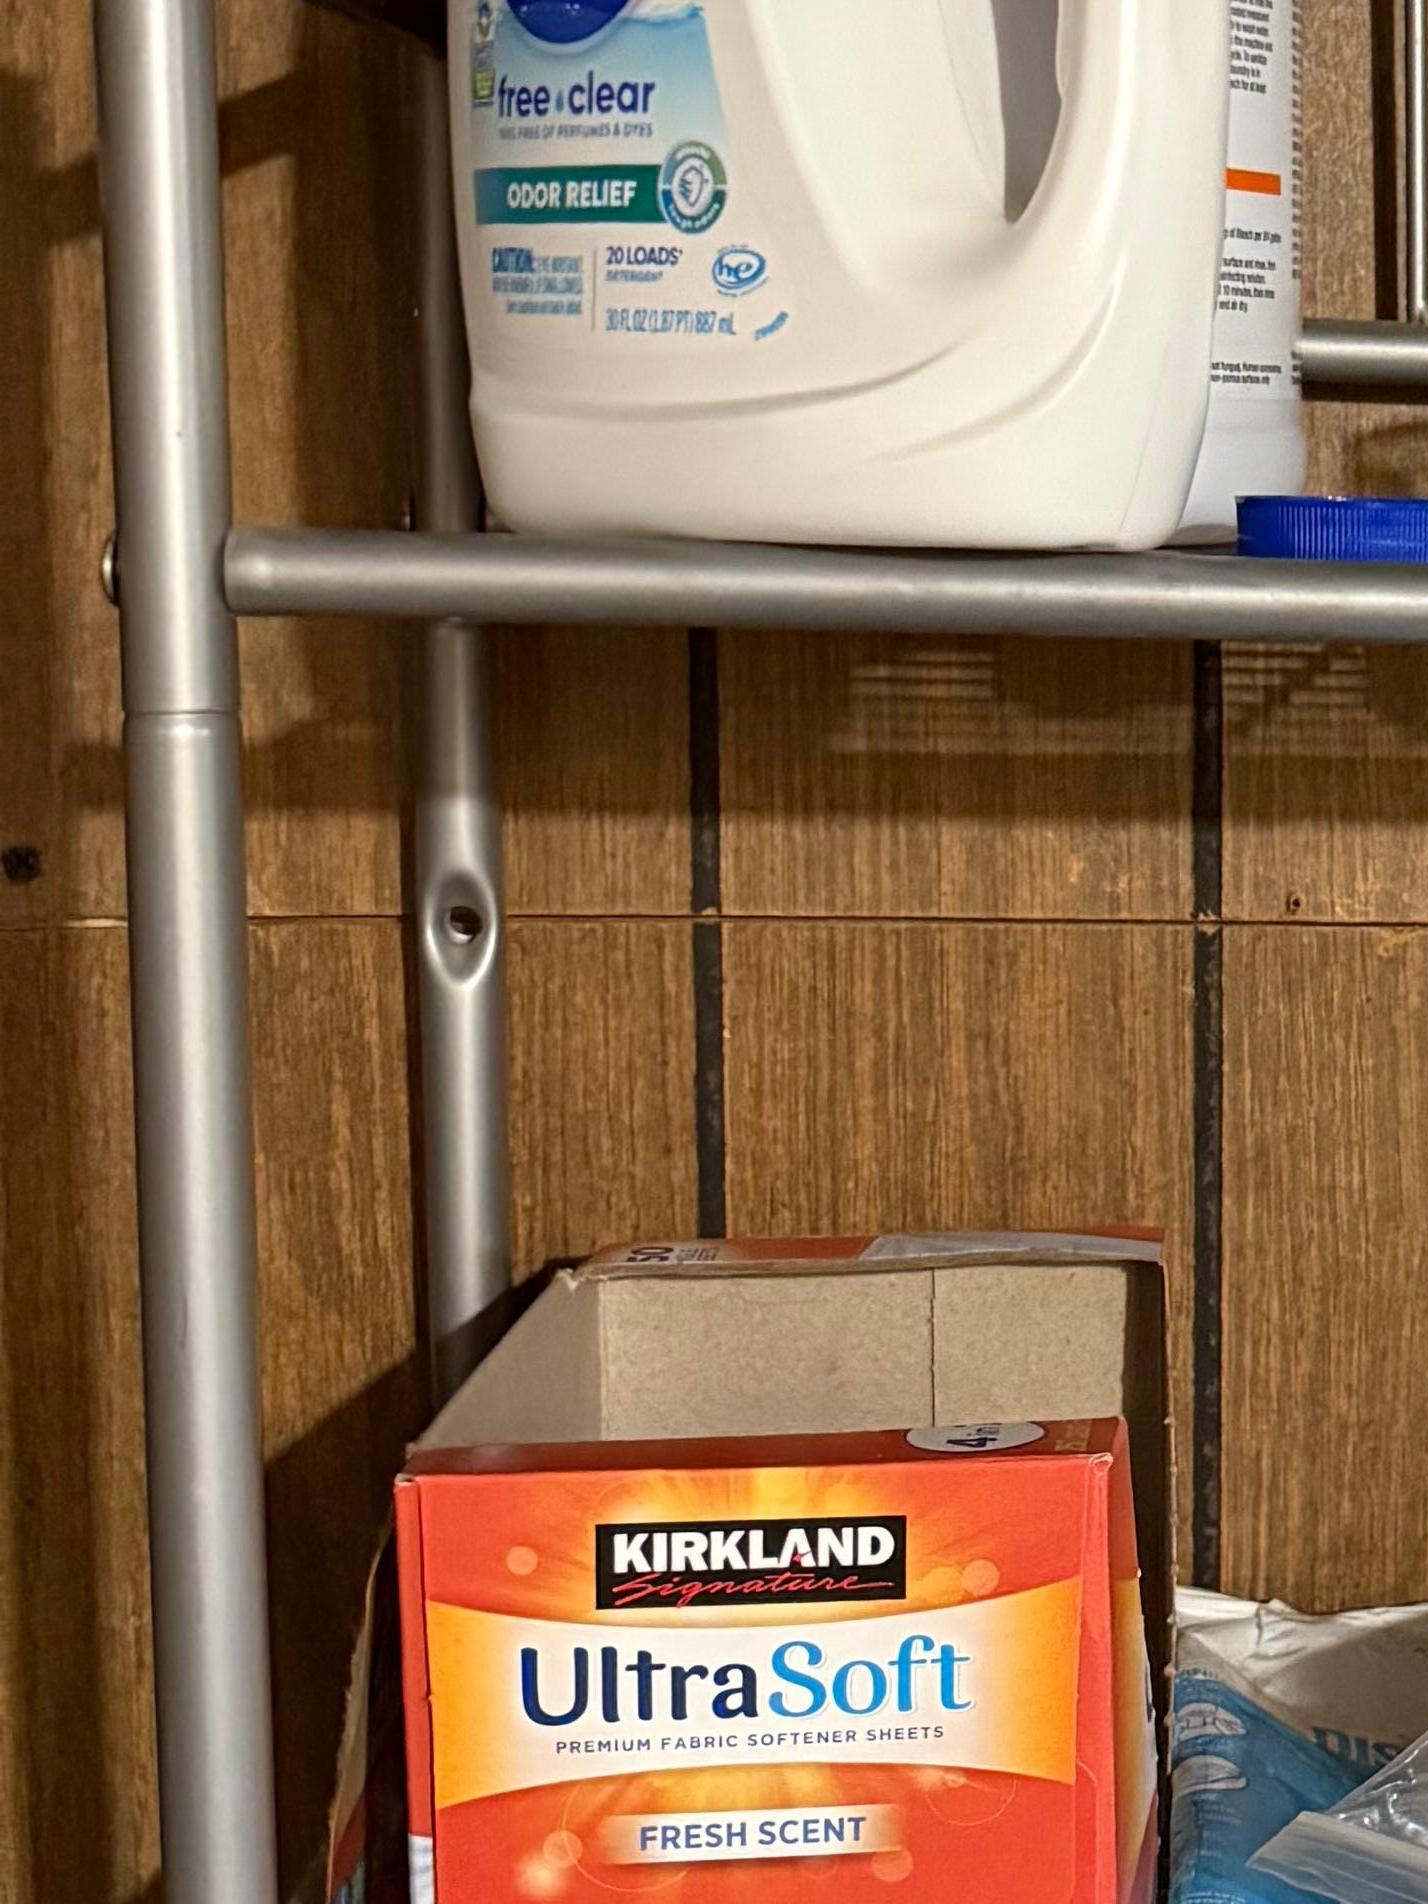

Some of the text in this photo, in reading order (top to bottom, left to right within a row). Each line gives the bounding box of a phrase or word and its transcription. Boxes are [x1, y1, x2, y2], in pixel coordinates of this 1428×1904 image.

[499, 75, 550, 117] free
[569, 70, 655, 114] clear
[557, 122, 611, 138] PERFUMES
[624, 122, 653, 137] DYES
[507, 180, 637, 209] ODOR RELIEF
[606, 247, 625, 266] 20
[613, 1526, 895, 1573] KIRKLAND
[612, 1571, 895, 1608] Signature
[520, 1634, 974, 1726] UltraSoft
[556, 1725, 945, 1754] PREMIUM FABRIC SOFTENER SHEETS
[639, 1816, 866, 1851] FRESH SCENT
